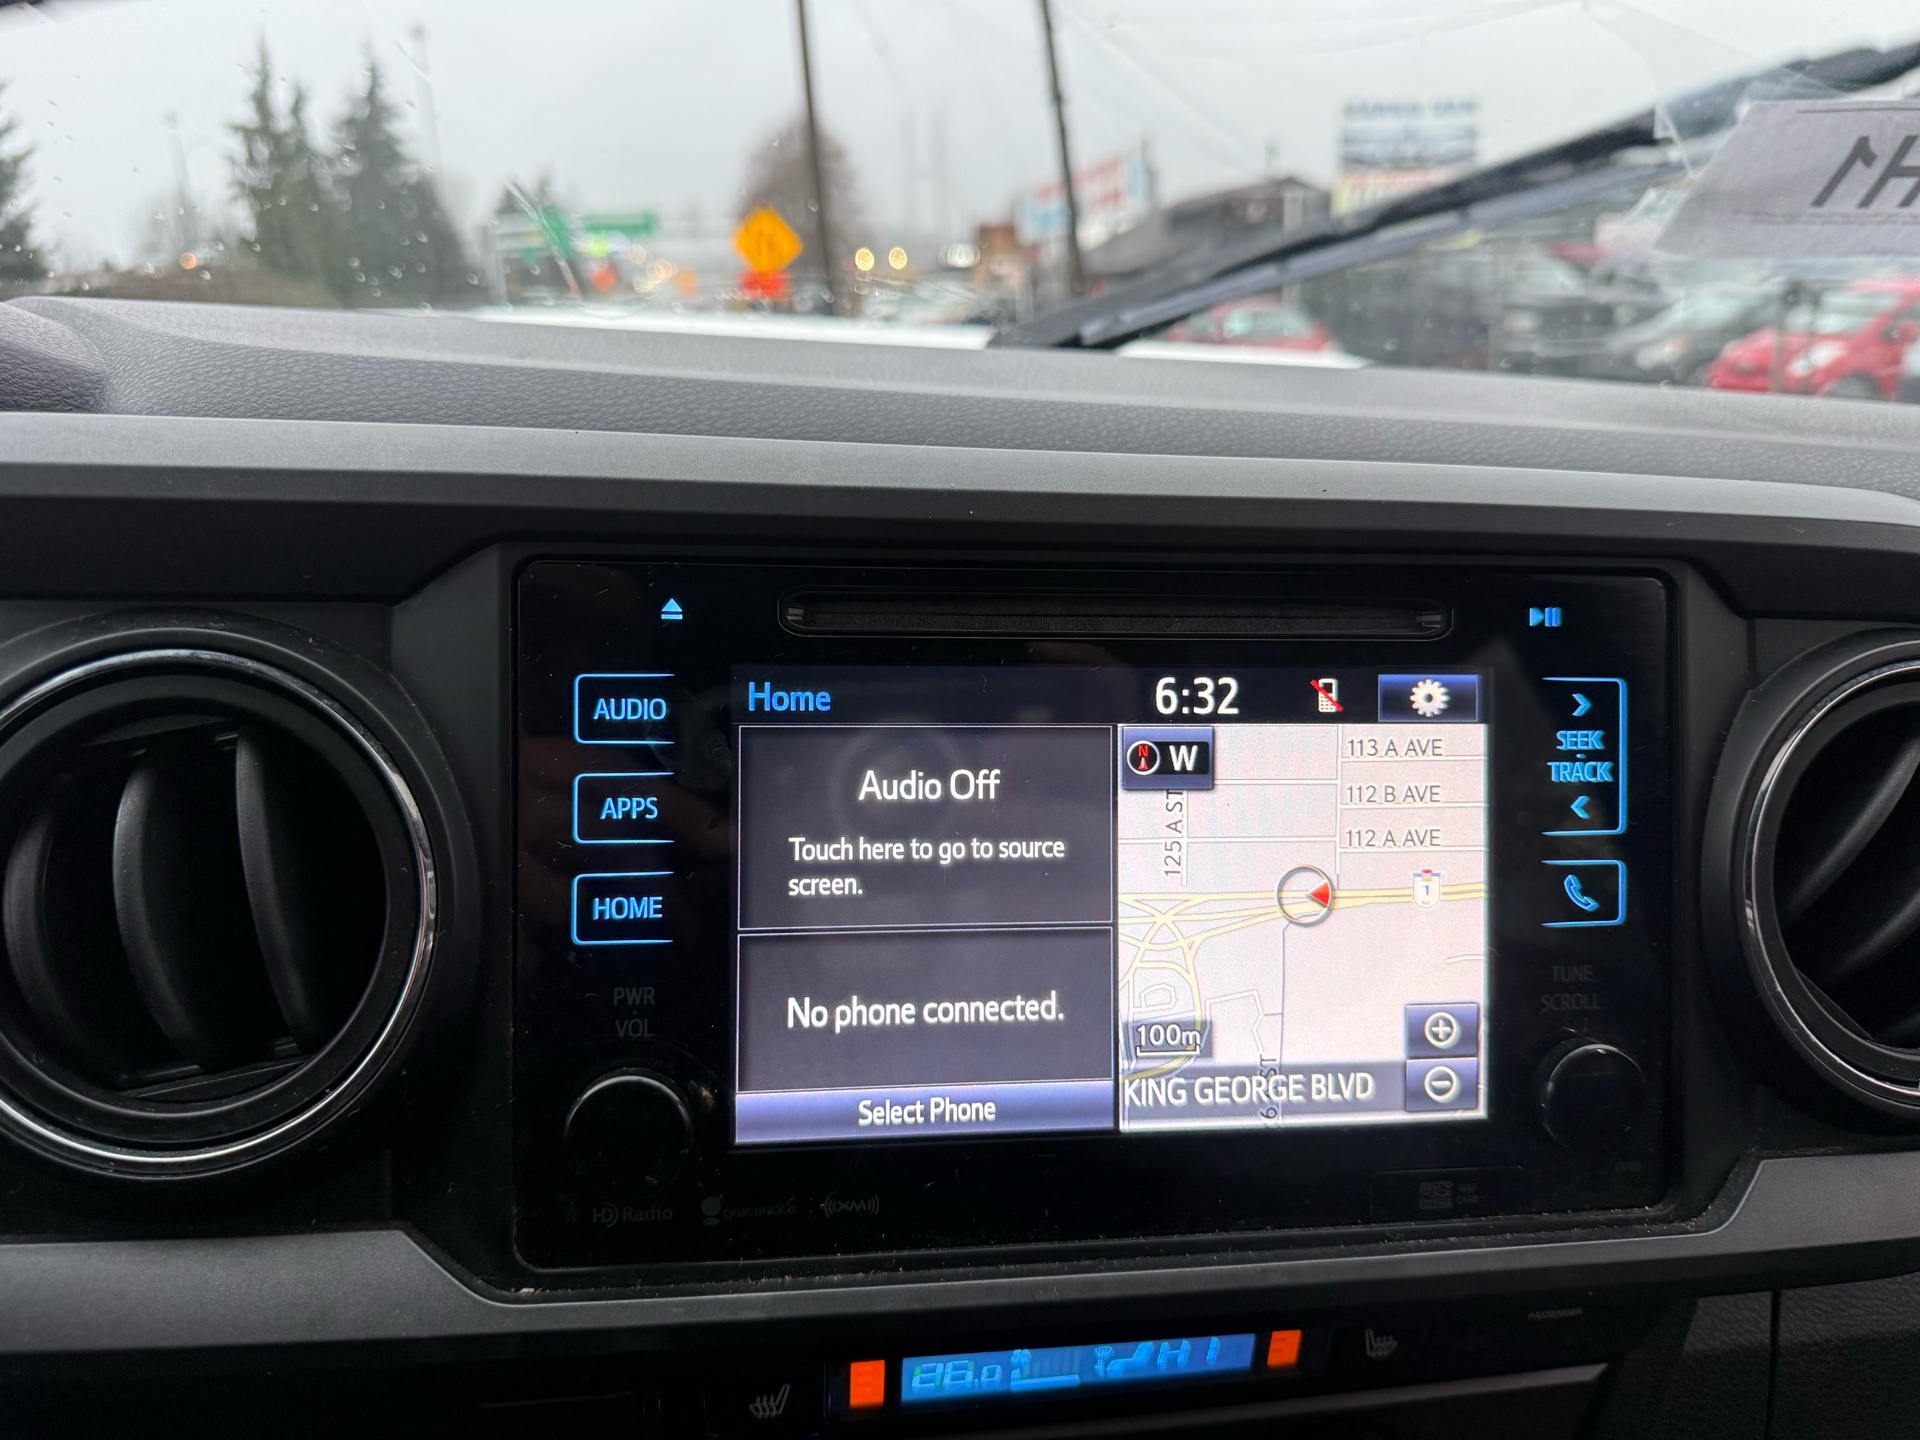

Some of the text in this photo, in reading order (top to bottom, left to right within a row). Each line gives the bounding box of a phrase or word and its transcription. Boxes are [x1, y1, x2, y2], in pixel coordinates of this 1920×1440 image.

[748, 682, 832, 712] Home
[1155, 677, 1239, 715] 6:32
[593, 698, 667, 721] AUDIO
[1138, 745, 1149, 757] N
[1347, 738, 1443, 757] 113 A AVE
[1556, 730, 1604, 751] SEEK
[1168, 744, 1198, 771] W
[1547, 761, 1614, 782] TRACK
[858, 769, 1001, 800] Audio Off
[1346, 785, 1441, 804] 112 B AVE
[601, 797, 658, 819] APPS
[1164, 789, 1184, 876] 125 A ST
[1346, 829, 1441, 847] 112 A AVE
[788, 837, 1065, 865] Touch here to go to source
[788, 877, 863, 896] screen.
[593, 896, 662, 920] HOME
[1550, 964, 1594, 983] TUNE
[614, 986, 656, 1006] PWR
[1540, 992, 1602, 1013] SCROLL
[787, 990, 1065, 1034] No phone connected.
[615, 1018, 656, 1038] VOL
[1136, 1024, 1201, 1047] 100m
[1124, 1076, 1187, 1107] KING
[1194, 1074, 1305, 1104] GEORGE
[1311, 1072, 1374, 1101] BLVD
[858, 1097, 997, 1125] Select Phone
[622, 1204, 674, 1222] Radio
[723, 1203, 797, 1221] gracenote
